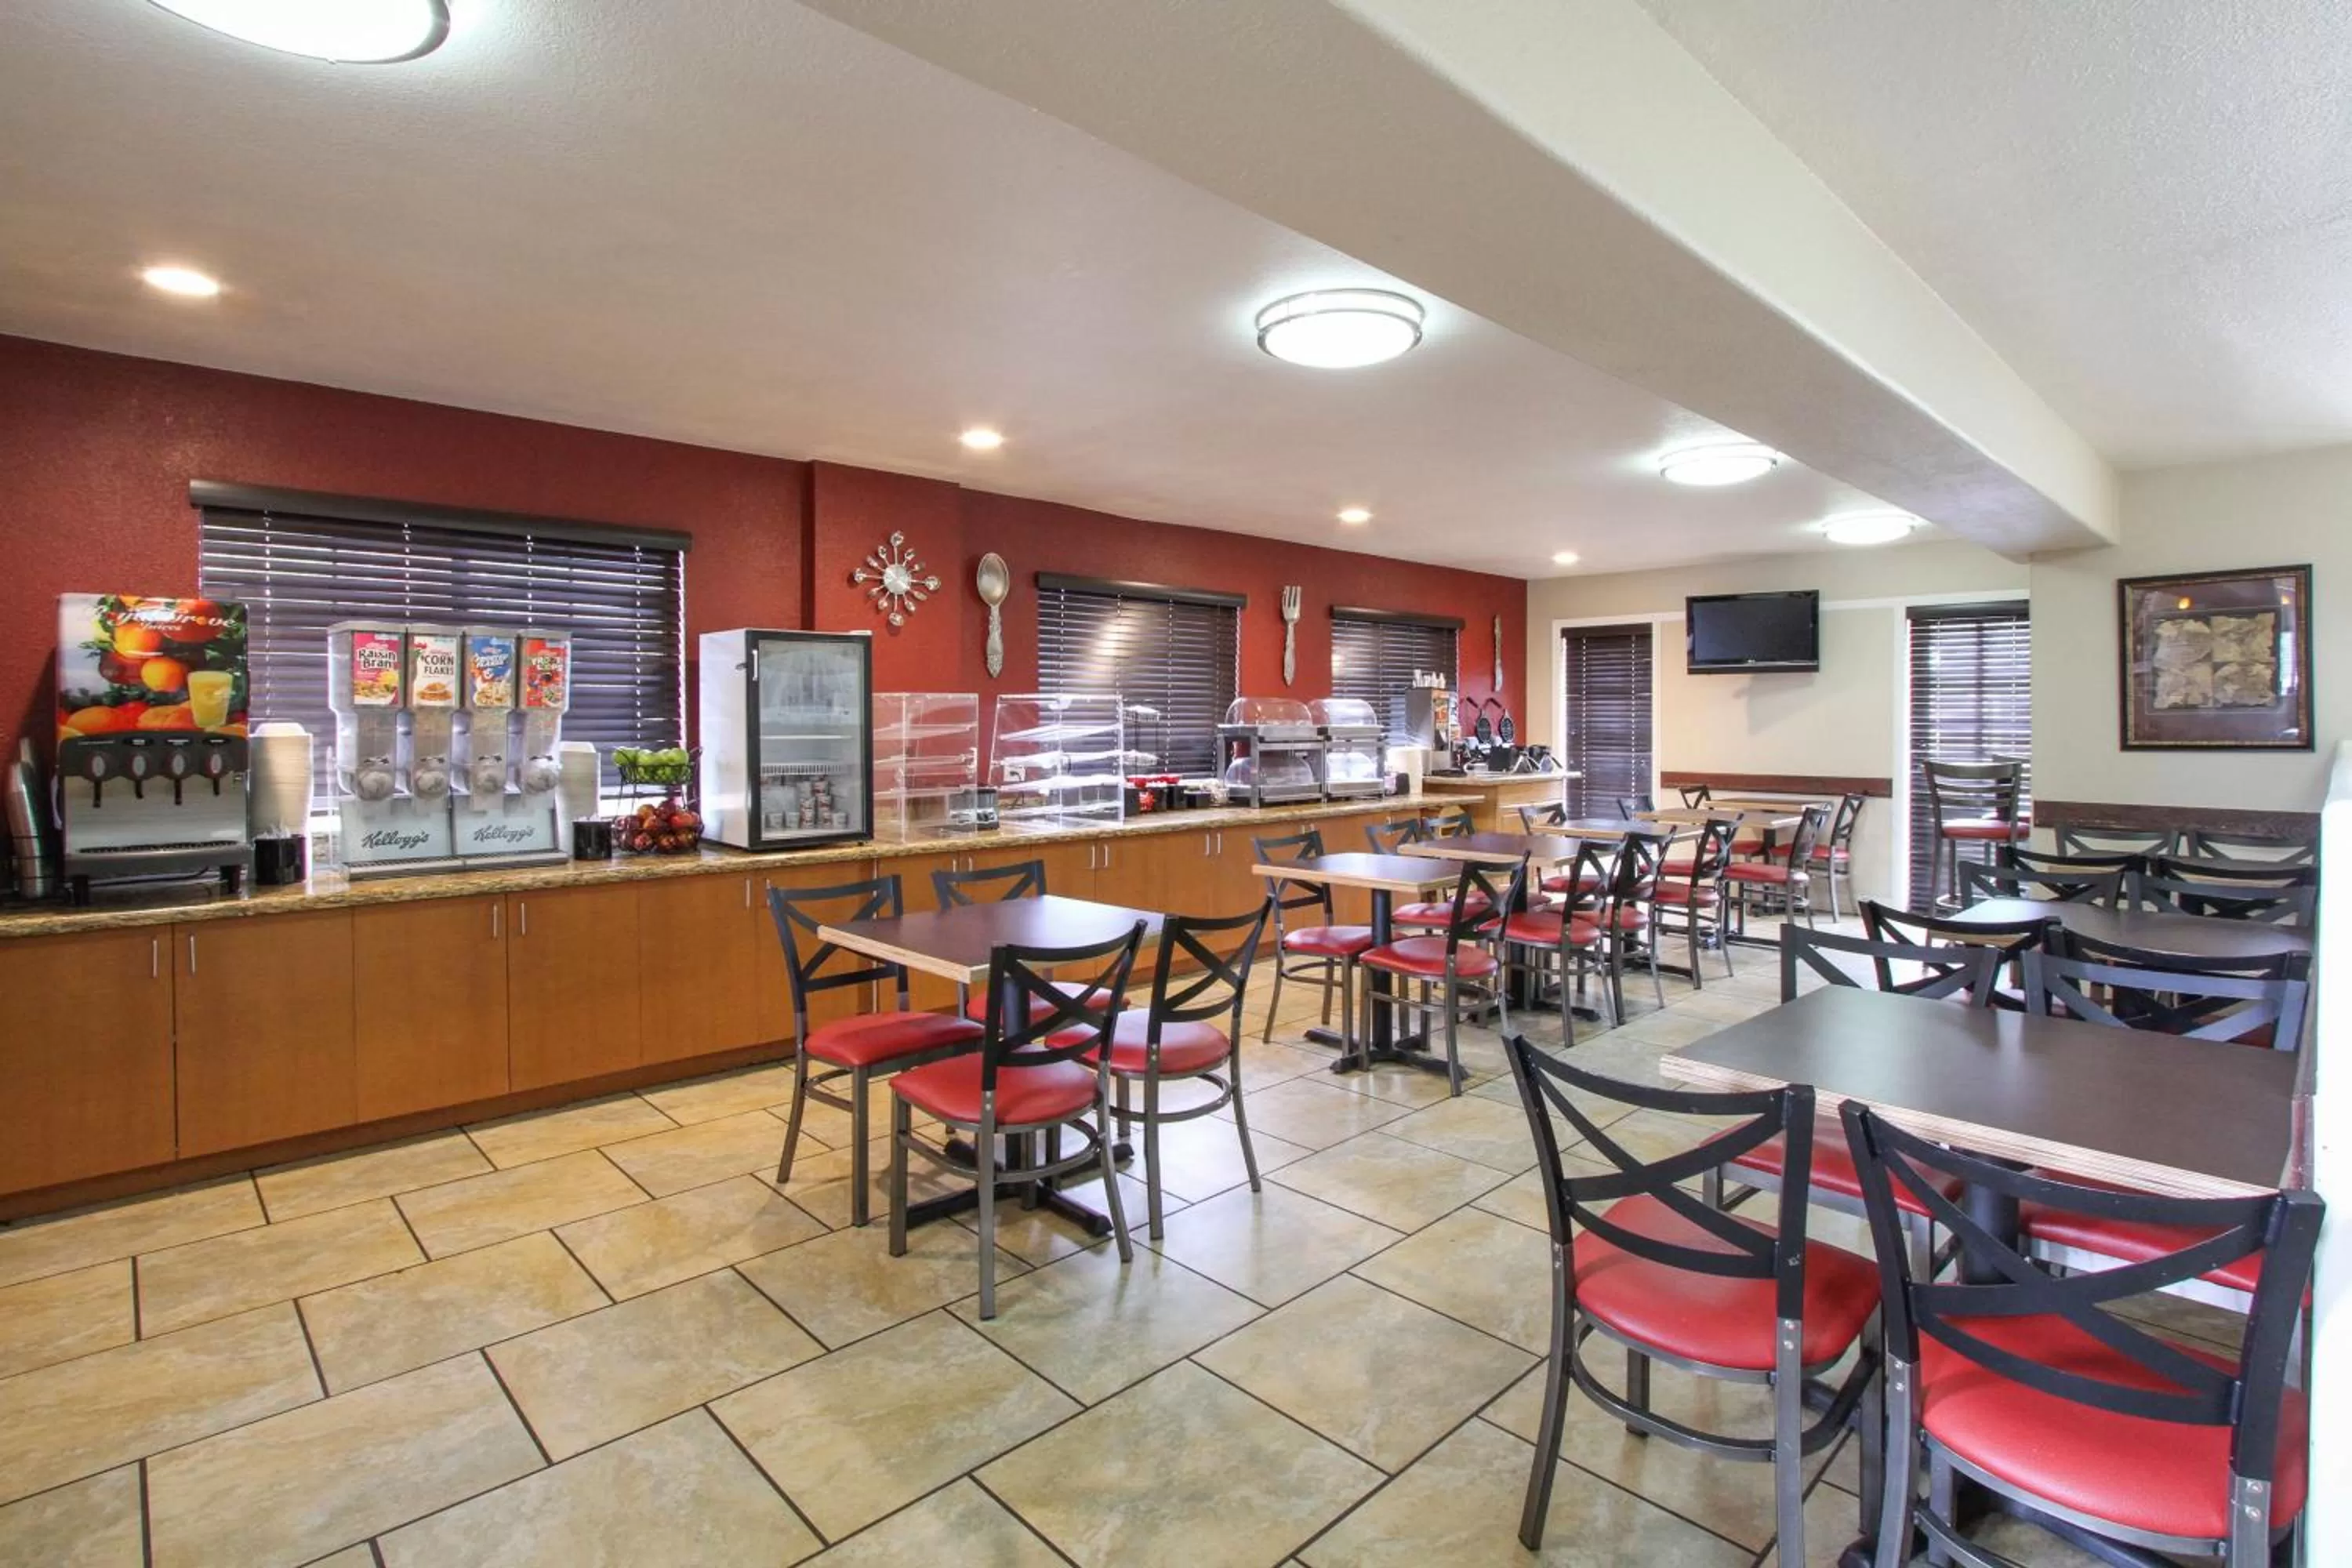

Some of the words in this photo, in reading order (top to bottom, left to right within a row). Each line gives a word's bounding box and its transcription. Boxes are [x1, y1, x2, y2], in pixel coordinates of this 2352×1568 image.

[358, 648, 396, 661] Raisin
[424, 654, 454, 666] CORN
[363, 659, 392, 669] Bran
[361, 830, 430, 850] Kellogg's
[473, 824, 535, 843] Kellogg's
